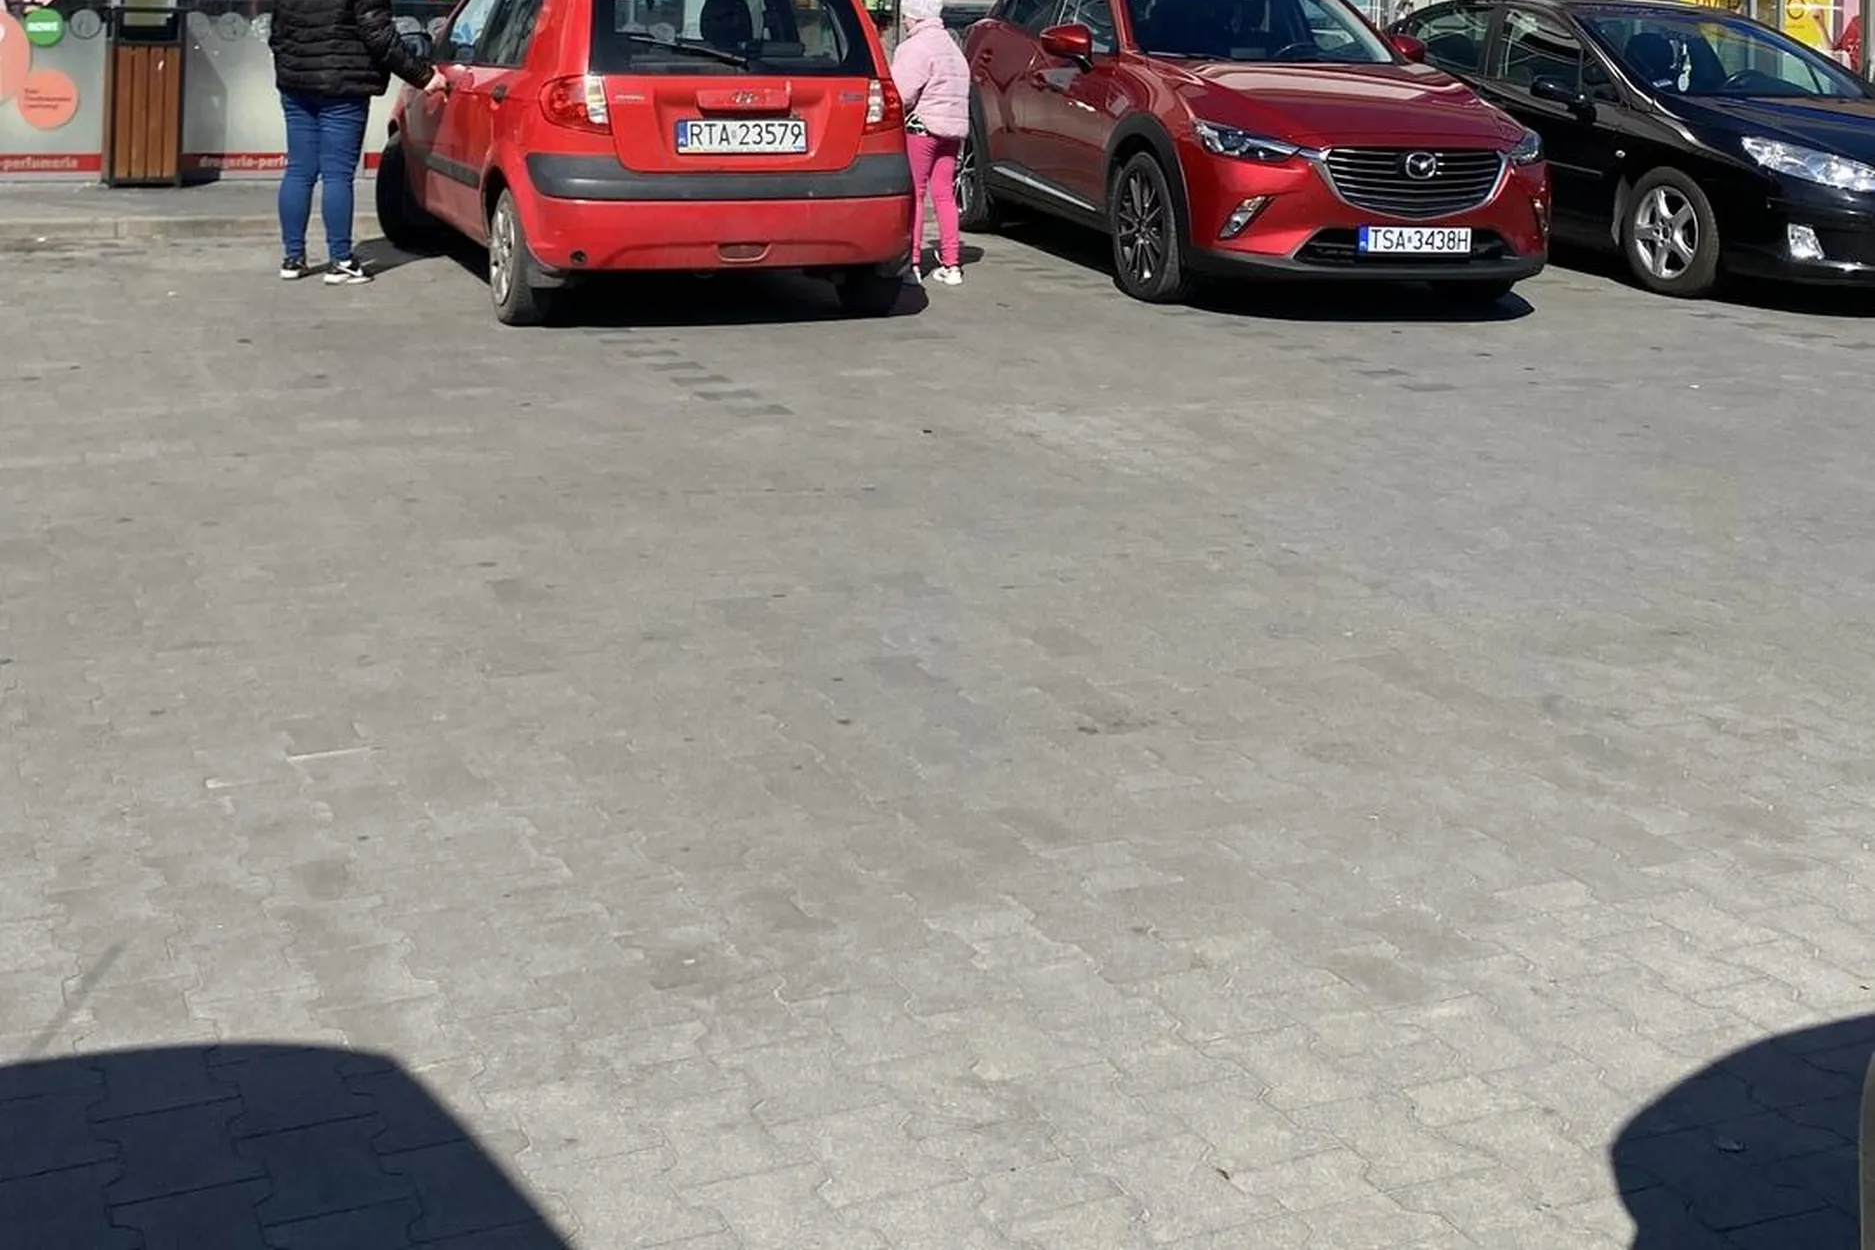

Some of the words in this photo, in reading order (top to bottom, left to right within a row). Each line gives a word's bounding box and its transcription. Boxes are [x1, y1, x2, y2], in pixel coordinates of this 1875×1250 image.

[690, 123, 731, 146] RTA
[738, 123, 802, 146] 23579
[1370, 229, 1406, 250] TSA
[1413, 230, 1469, 250] 3438H
